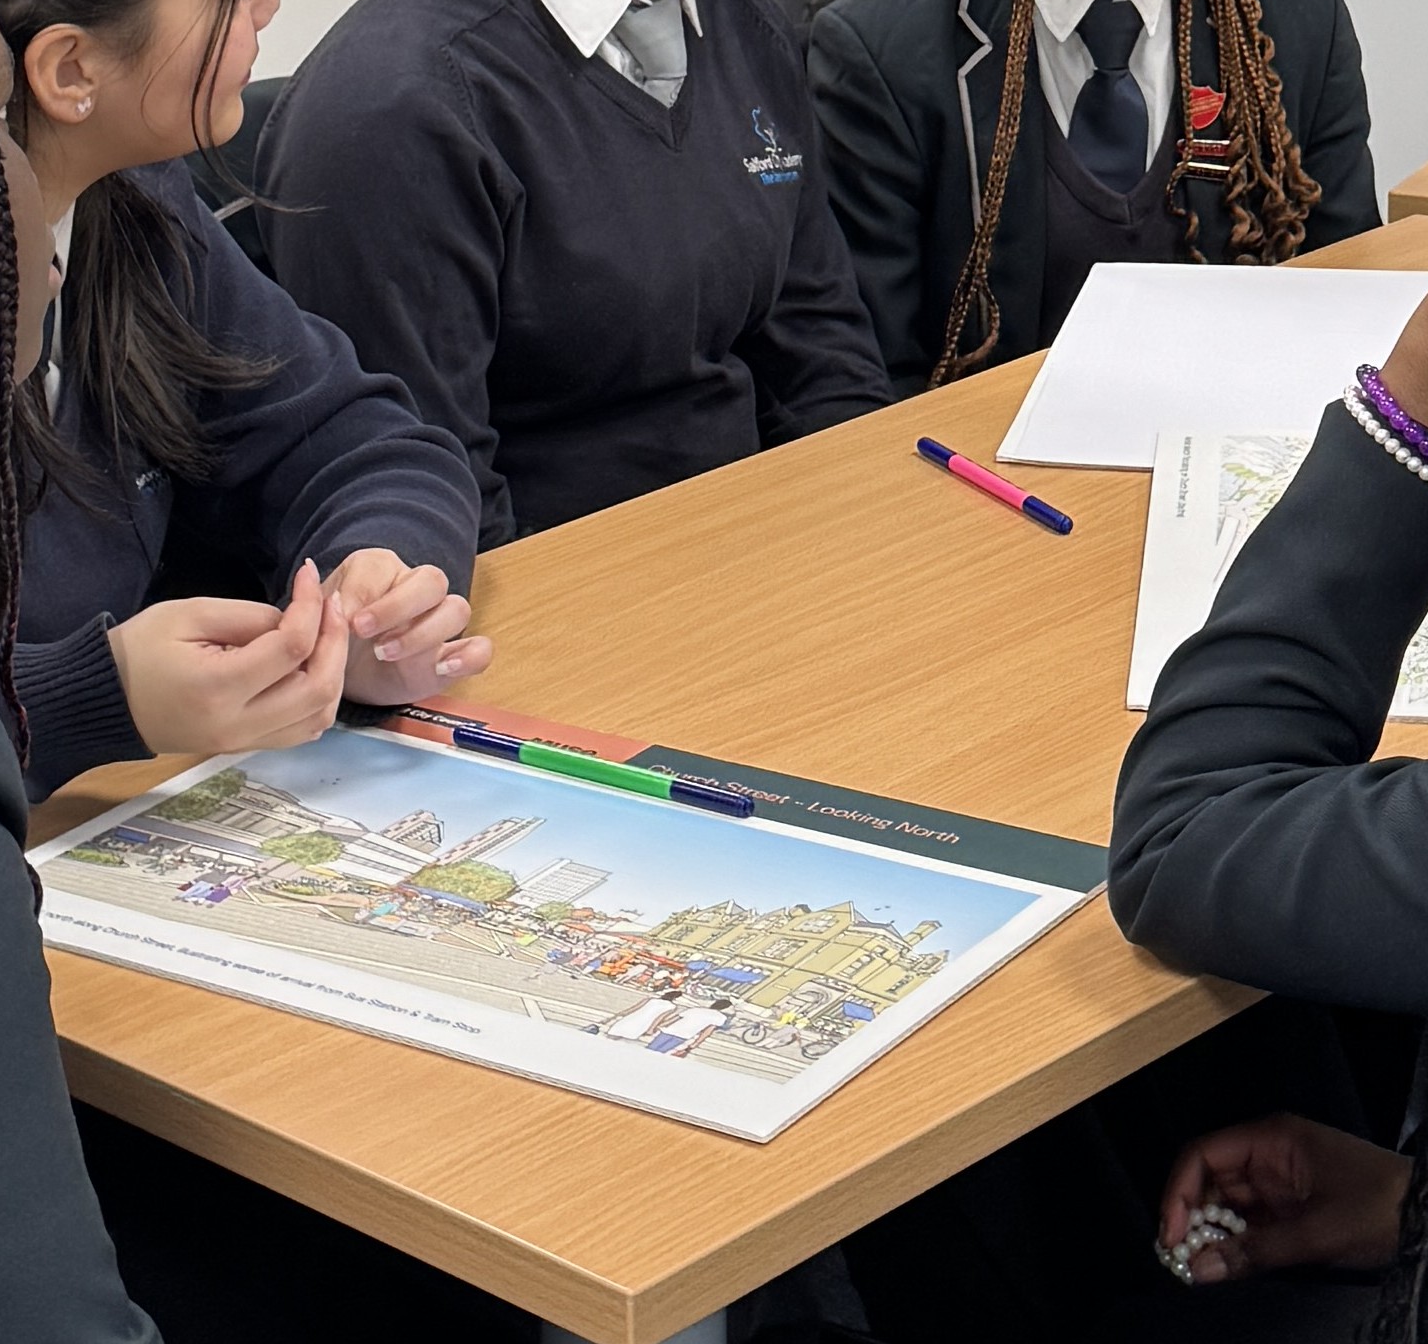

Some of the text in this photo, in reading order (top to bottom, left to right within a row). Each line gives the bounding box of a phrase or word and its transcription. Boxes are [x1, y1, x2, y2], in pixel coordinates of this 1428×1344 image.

[727, 781, 791, 804] Street
[807, 801, 894, 830] Looking
[894, 821, 961, 845] North
[316, 984, 343, 997] from
[367, 998, 408, 1015] Station
[451, 1021, 482, 1035] Stop
